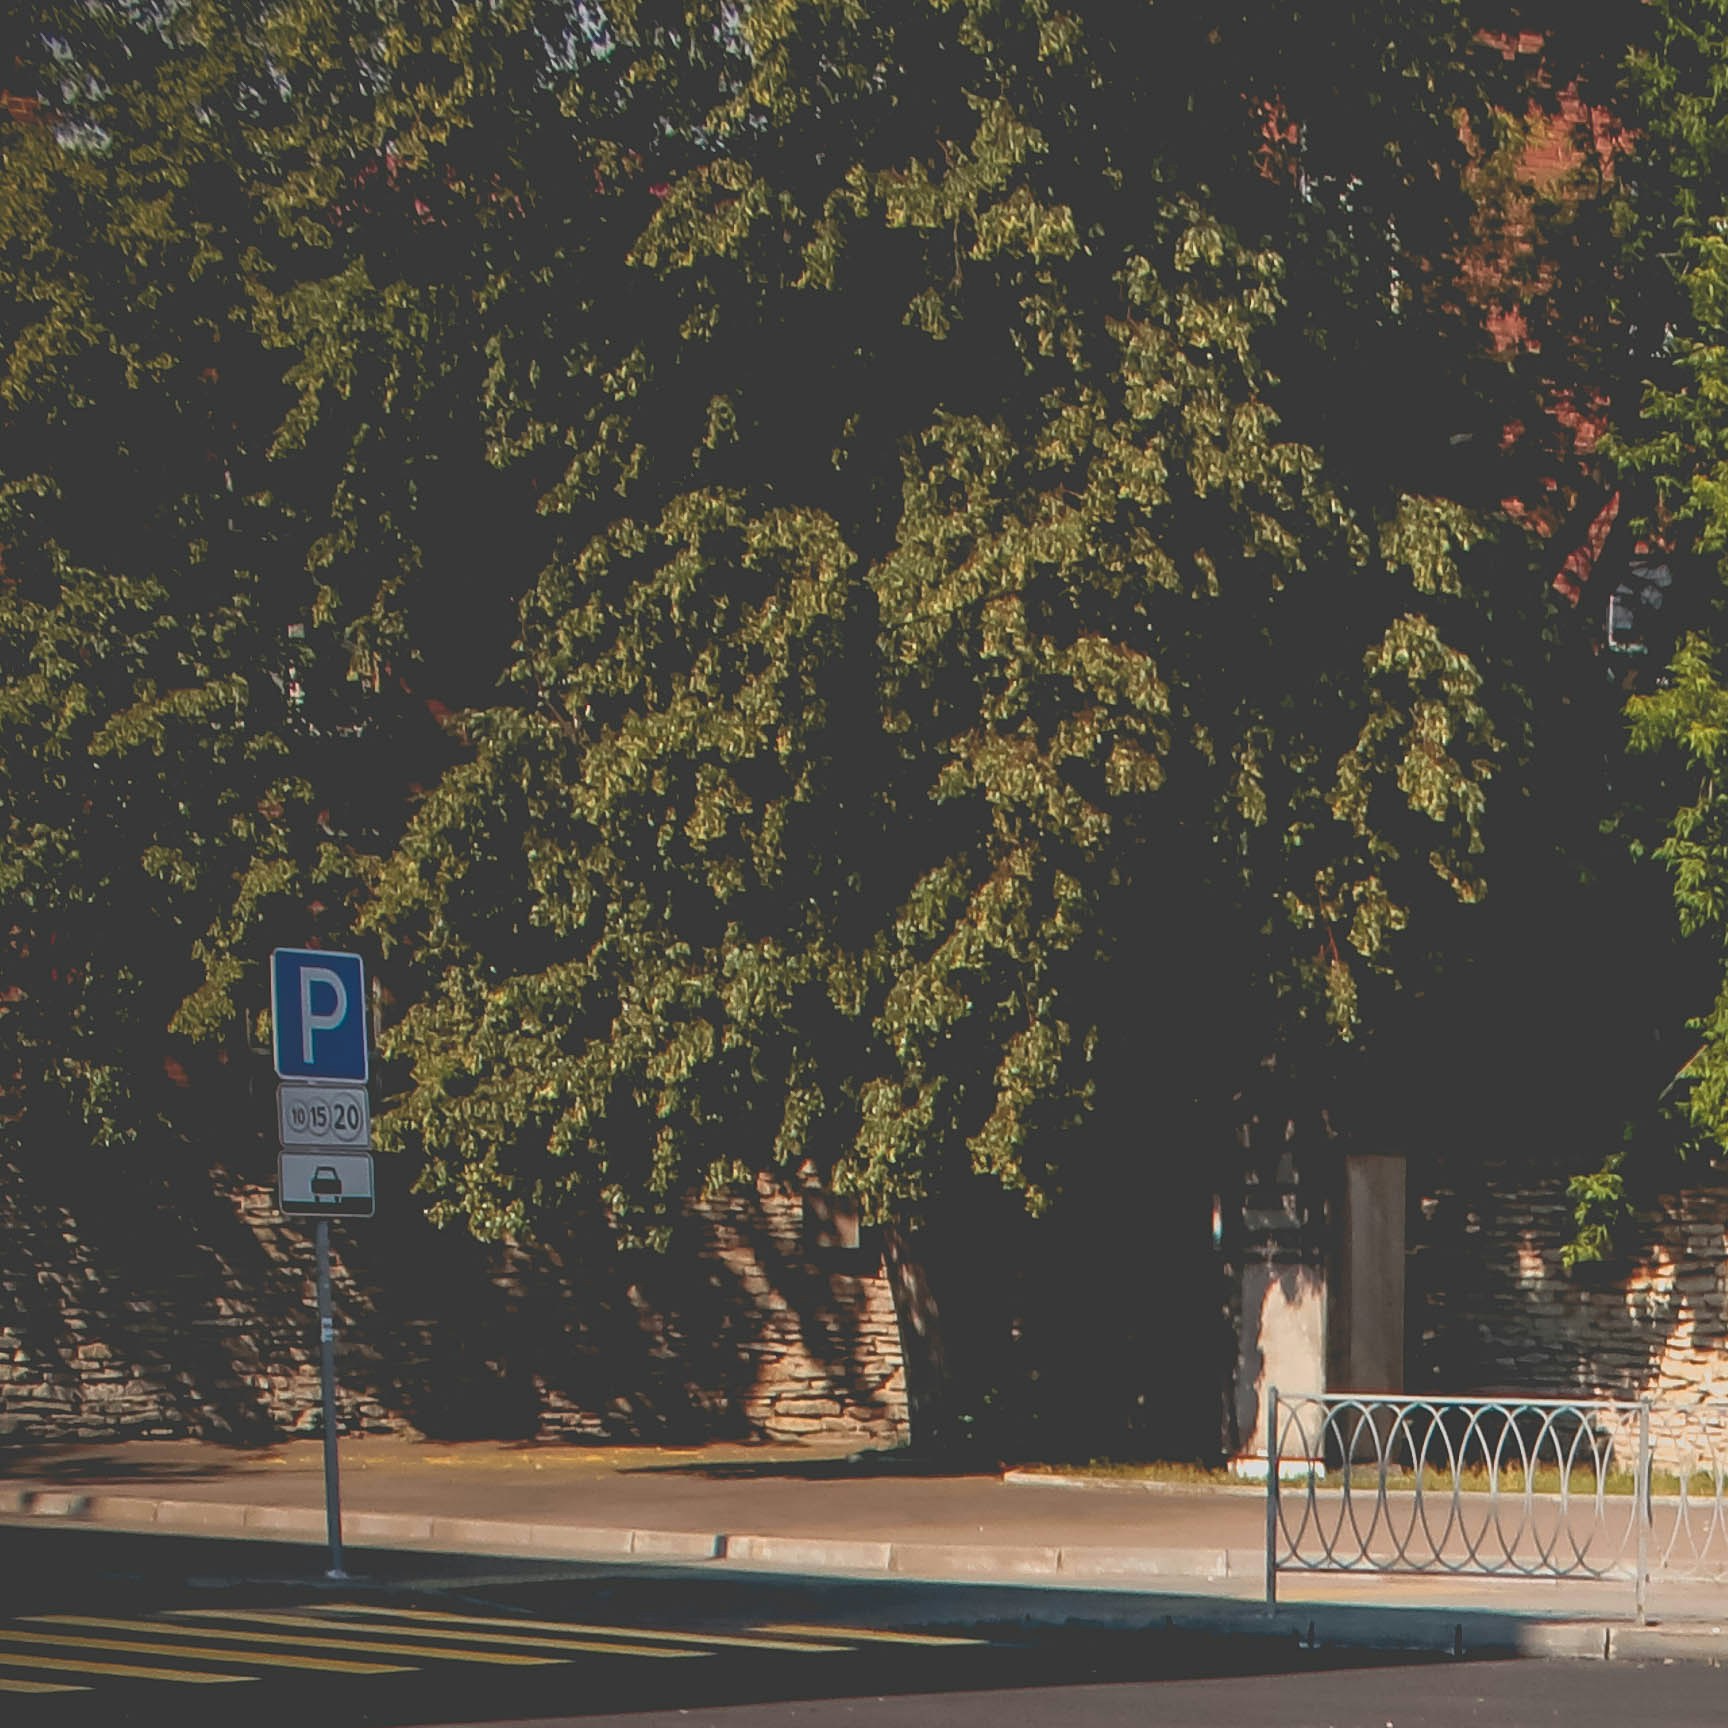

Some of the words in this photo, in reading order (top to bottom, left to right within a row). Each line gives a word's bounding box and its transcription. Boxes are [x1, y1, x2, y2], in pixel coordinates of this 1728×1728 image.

[300, 966, 347, 1064] P
[291, 1107, 306, 1125] 10
[310, 1105, 328, 1128] 15
[334, 1103, 360, 1130] 20
